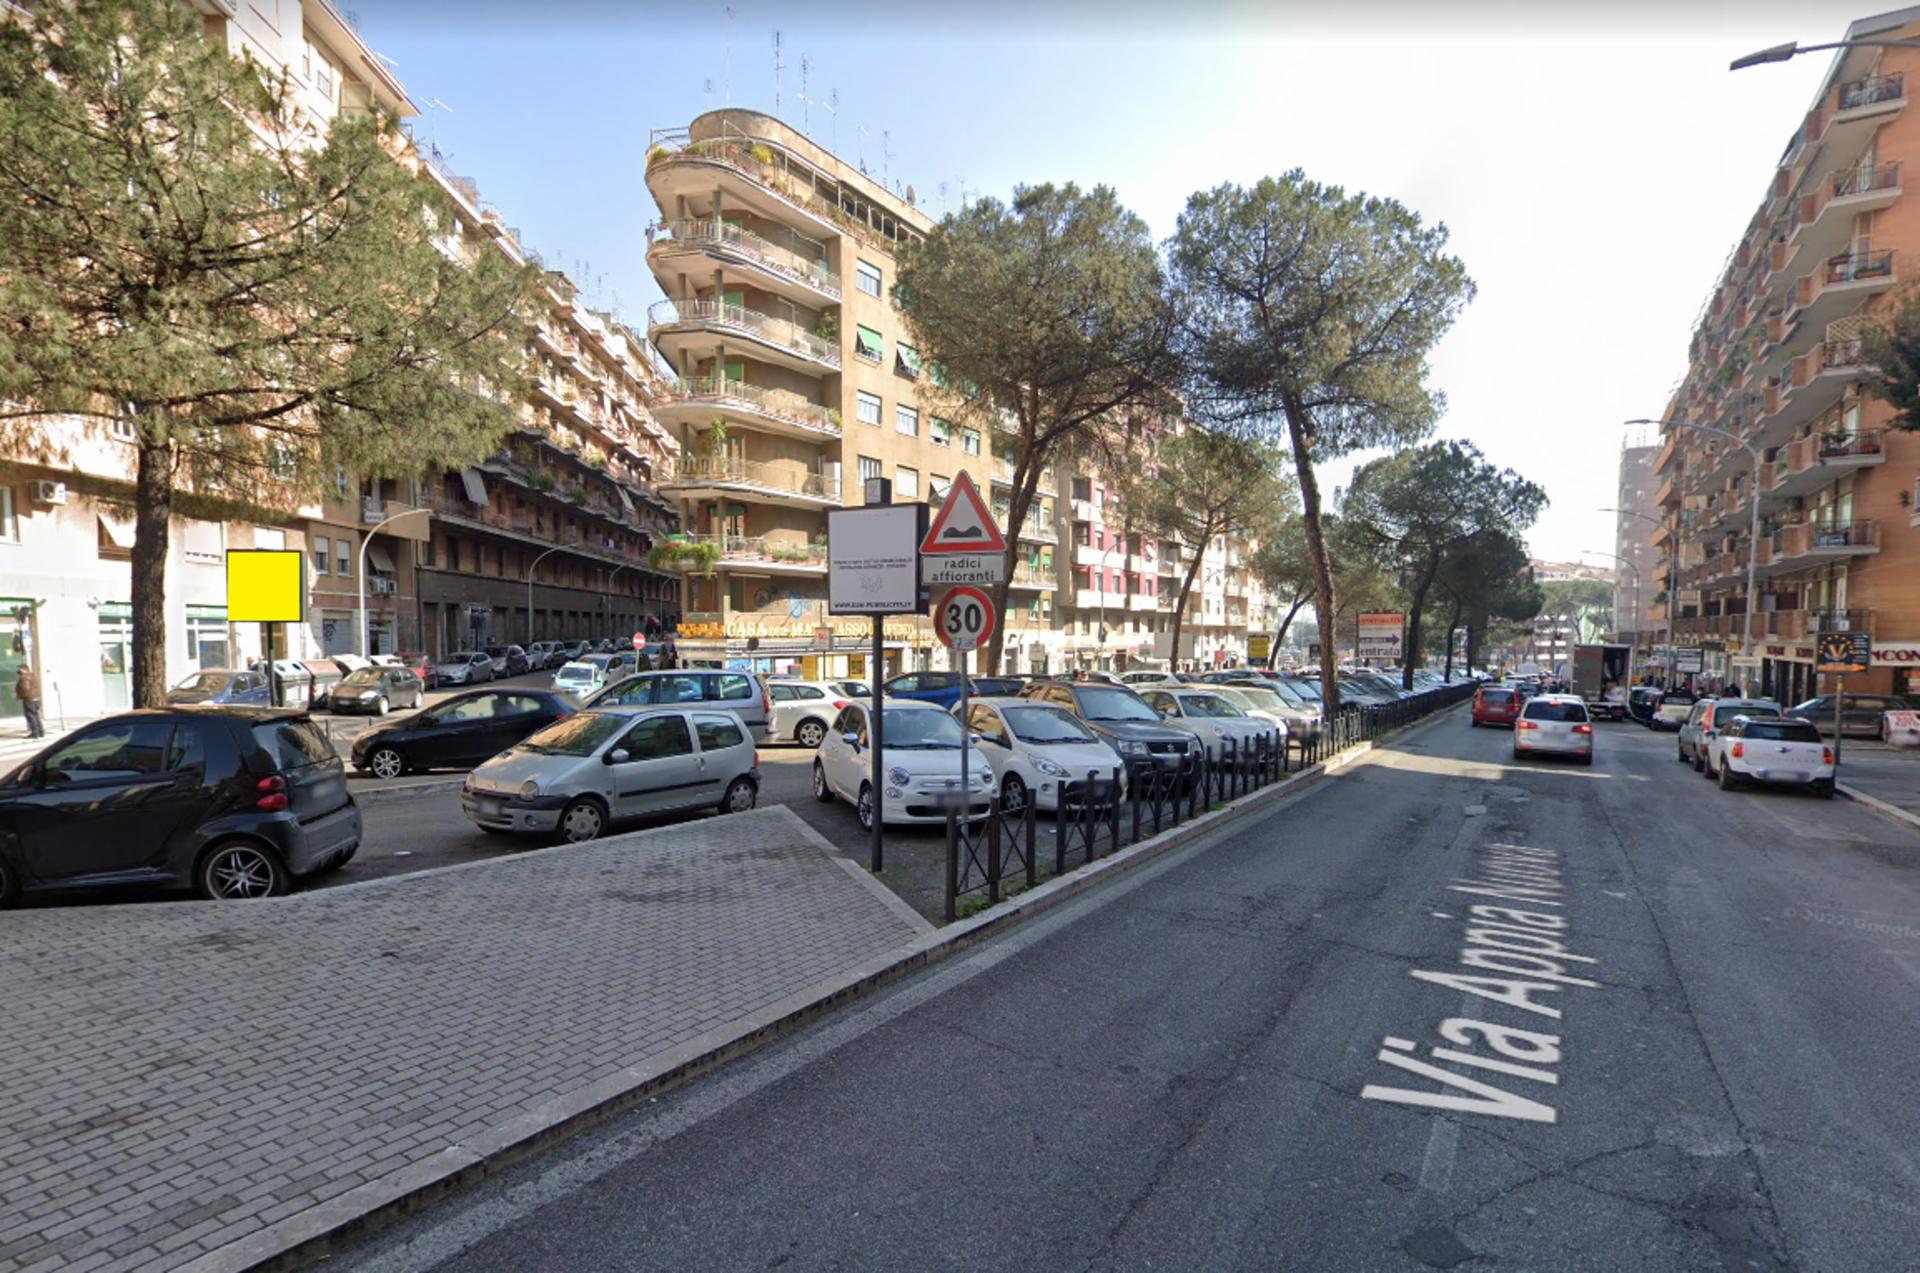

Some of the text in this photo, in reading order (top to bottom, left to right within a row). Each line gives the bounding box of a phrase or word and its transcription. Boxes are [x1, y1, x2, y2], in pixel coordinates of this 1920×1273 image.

[944, 558, 981, 569] radici
[932, 570, 994, 582] affioranti
[947, 604, 982, 634] 30
[726, 622, 767, 638] CASA
[1360, 647, 1400, 656] entrata
[1408, 904, 1603, 1019] Appia
[1361, 1017, 1561, 1123] Via
